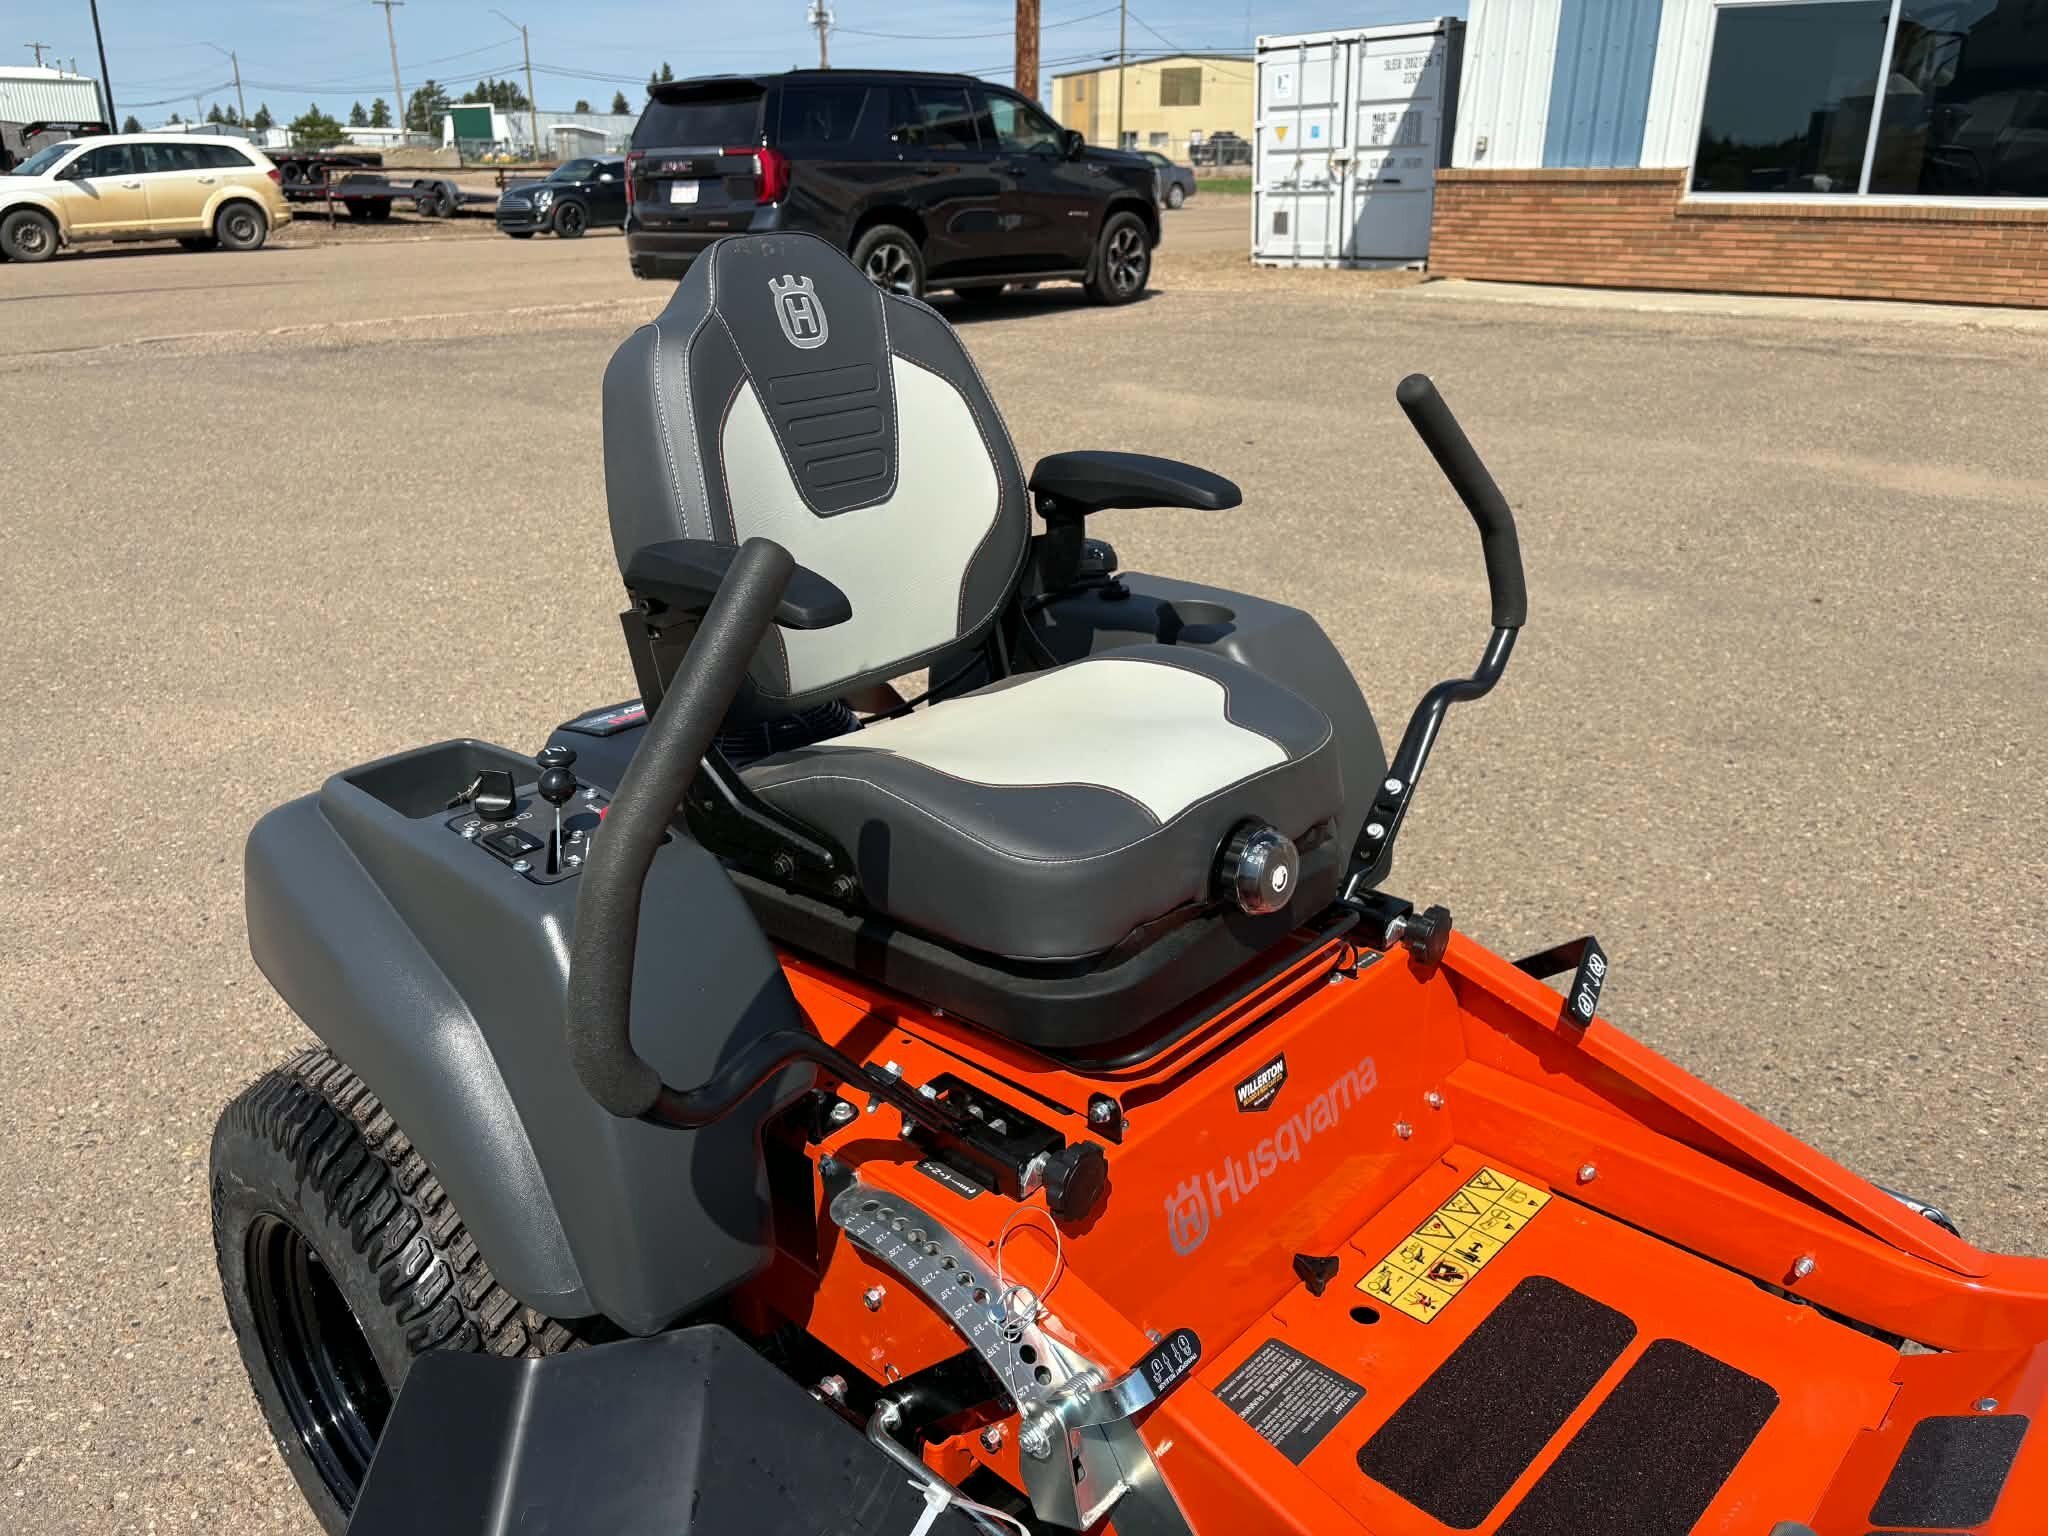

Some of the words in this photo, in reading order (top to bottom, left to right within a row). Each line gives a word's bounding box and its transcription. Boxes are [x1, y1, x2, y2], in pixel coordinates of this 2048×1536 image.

[1238, 1059, 1283, 1103] WILLERTON
[1207, 1055, 1379, 1219] Husqvarna
[1287, 1358, 1302, 1374] ONCE
[1266, 1371, 1289, 1391] ENGINE
[1347, 1389, 1359, 1399] TO
[1333, 1397, 1351, 1415] START
